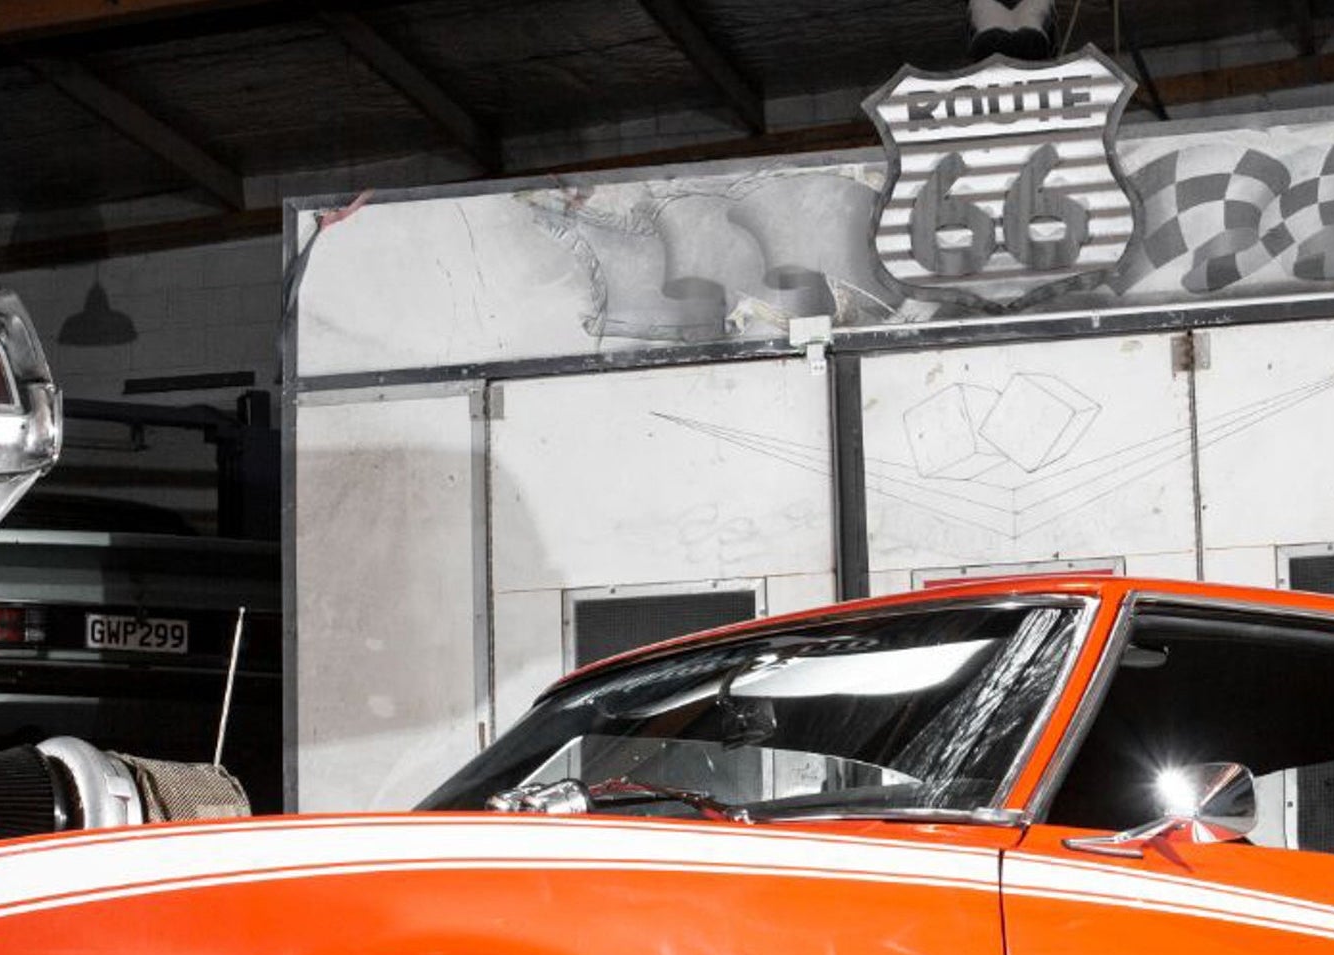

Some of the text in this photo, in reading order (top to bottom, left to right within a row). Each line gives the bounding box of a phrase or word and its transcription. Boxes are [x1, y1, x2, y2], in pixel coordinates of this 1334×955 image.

[907, 75, 1093, 131] ROUTE
[910, 143, 1089, 276] 66
[90, 620, 185, 648] GWP299
